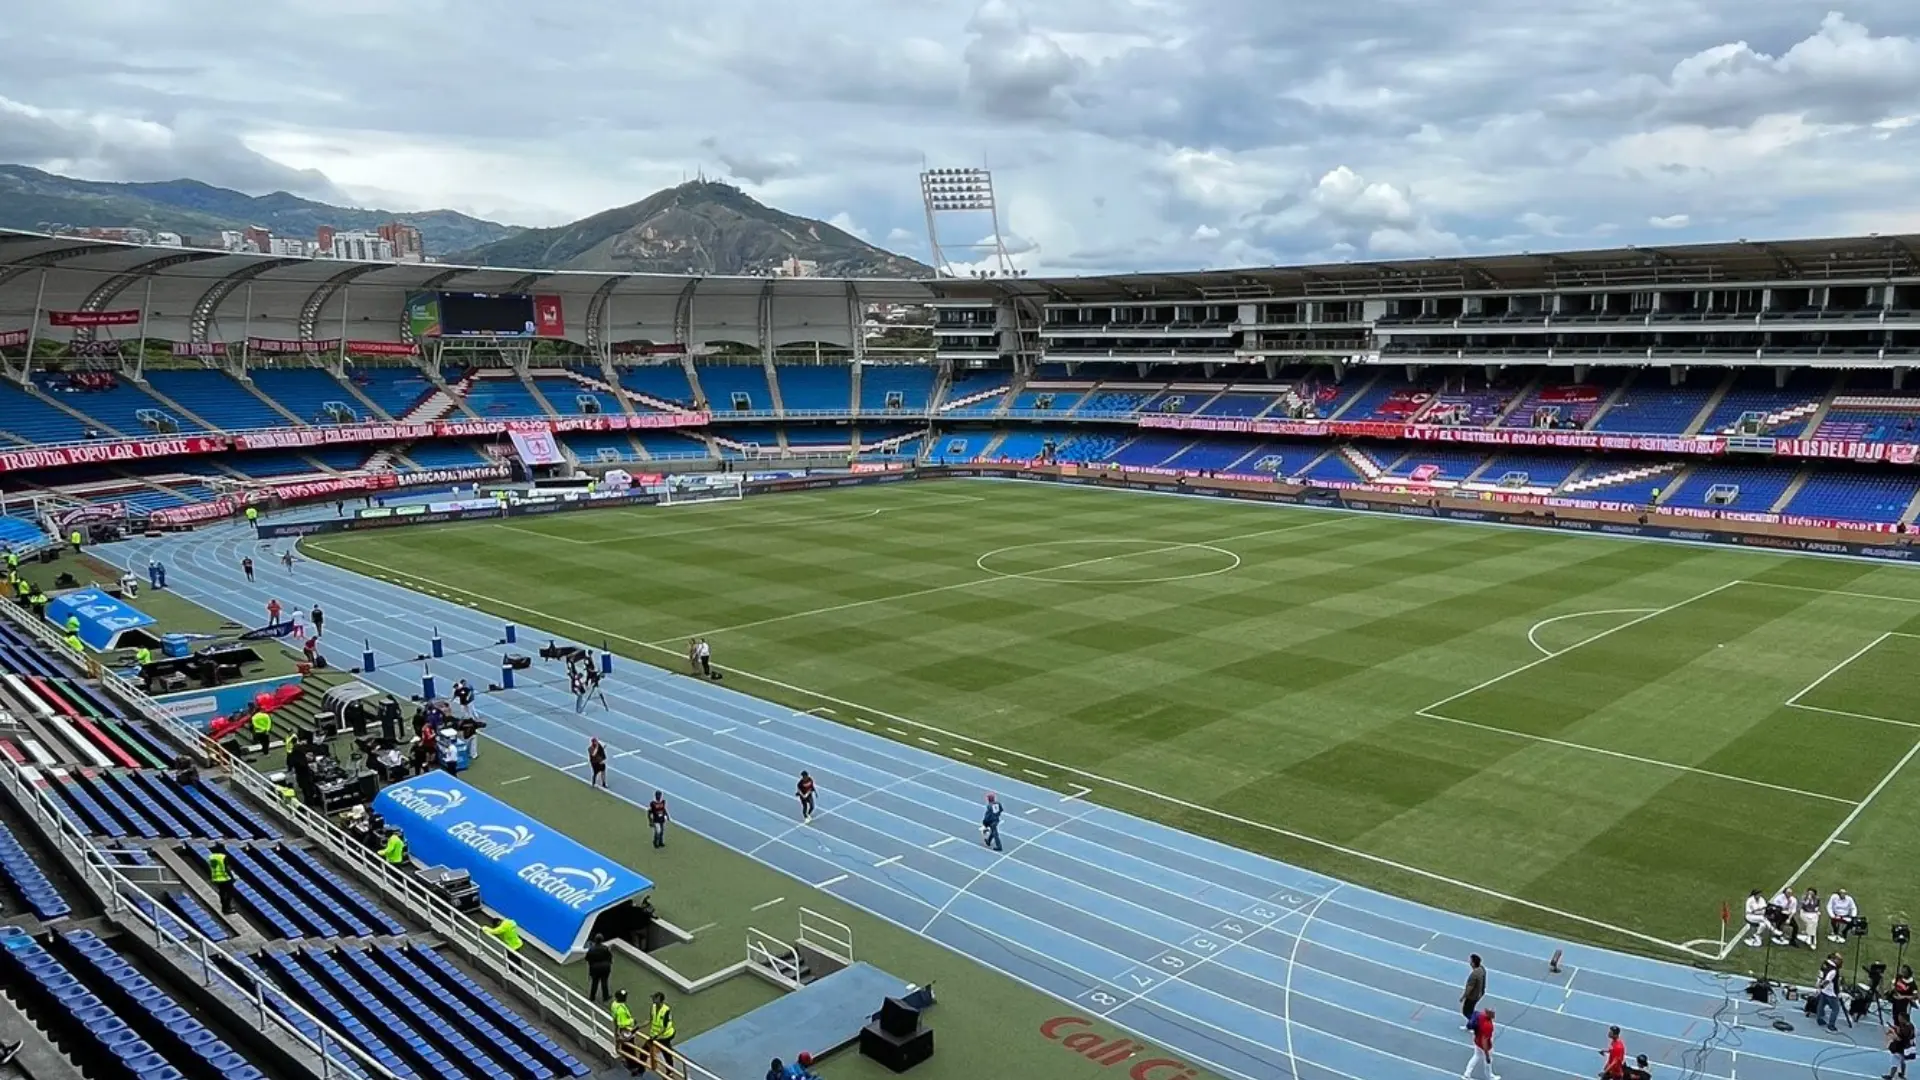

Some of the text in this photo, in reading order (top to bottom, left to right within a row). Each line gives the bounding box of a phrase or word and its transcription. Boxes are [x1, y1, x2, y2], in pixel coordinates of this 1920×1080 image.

[453, 423, 506, 436] DIABLOS
[556, 419, 592, 431] NORTE
[1404, 428, 1421, 439] LA
[1461, 431, 1538, 445] ESTRELLA ROJA
[1555, 434, 1631, 449] BEATRIZ URIBE
[1639, 437, 1696, 453] SENTIMIENTO
[2, 439, 190, 471] TRIBUNA POPULAR NORTE
[1793, 440, 1819, 457] LOS
[1820, 440, 1846, 458] DEL
[1807, 543, 1848, 553] APUESTA
[387, 785, 445, 821] Electrolit
[447, 821, 513, 861] Electrolit
[518, 863, 595, 909] Electrolit
[1280, 894, 1302, 904] 2
[1253, 907, 1276, 918] 3
[1222, 922, 1244, 935] 4
[1194, 938, 1219, 951] 5
[1161, 955, 1185, 969] 6
[1130, 973, 1155, 988] 7
[1090, 991, 1117, 1007] 8
[1039, 1016, 1145, 1067] Cali
